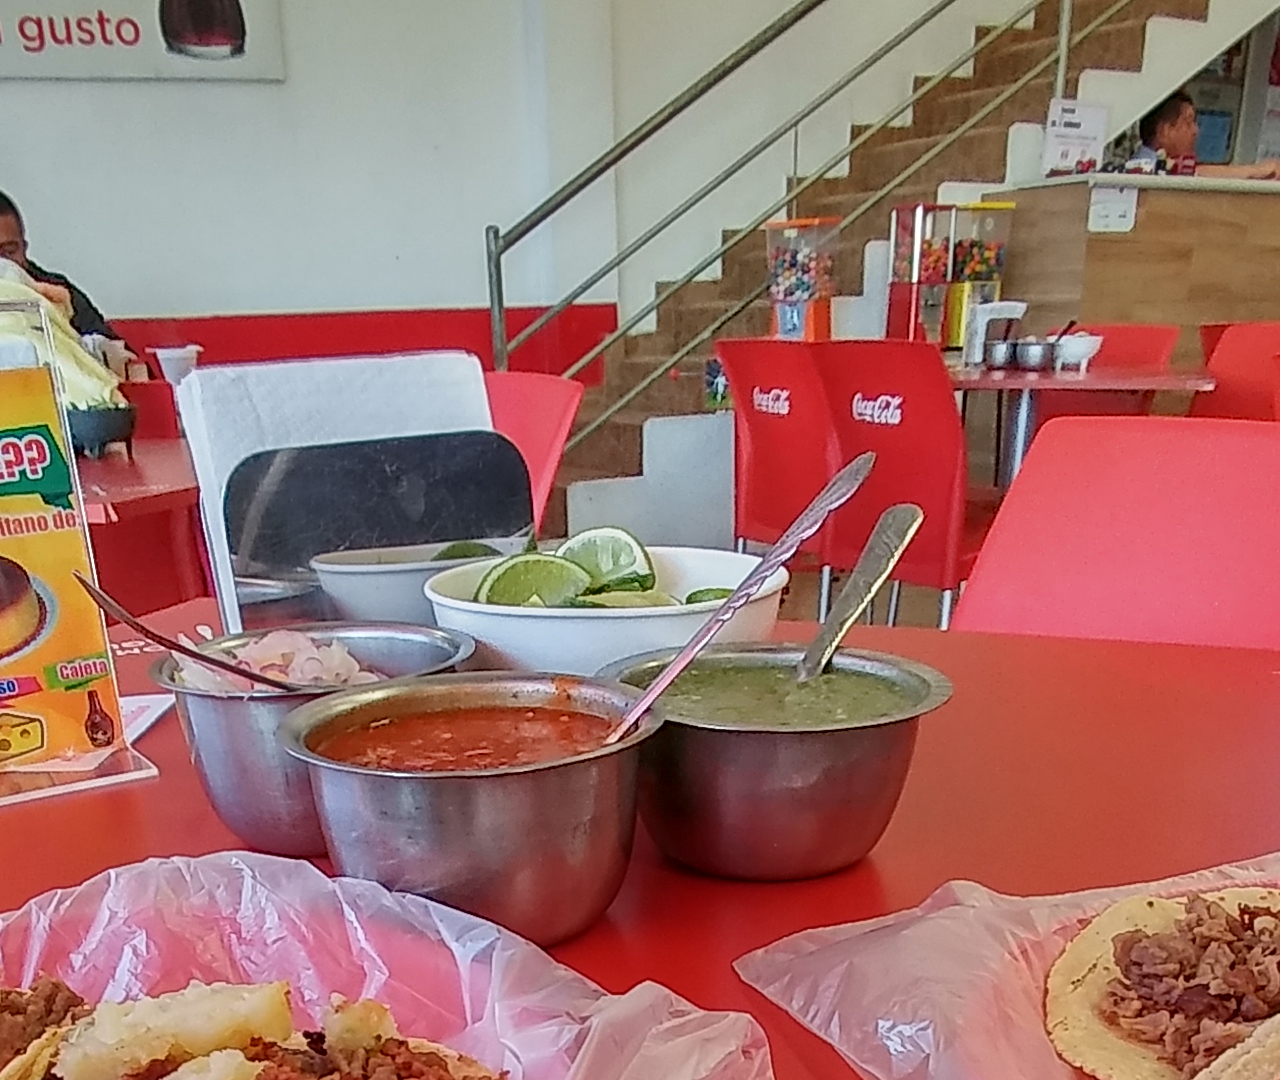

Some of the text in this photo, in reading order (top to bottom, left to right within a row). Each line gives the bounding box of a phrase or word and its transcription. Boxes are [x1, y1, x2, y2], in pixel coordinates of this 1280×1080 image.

[17, 9, 142, 53] gusto
[752, 386, 792, 416] Coca-Cola
[852, 392, 904, 425] Coca-Cola
[59, 658, 109, 681] Cajeta
